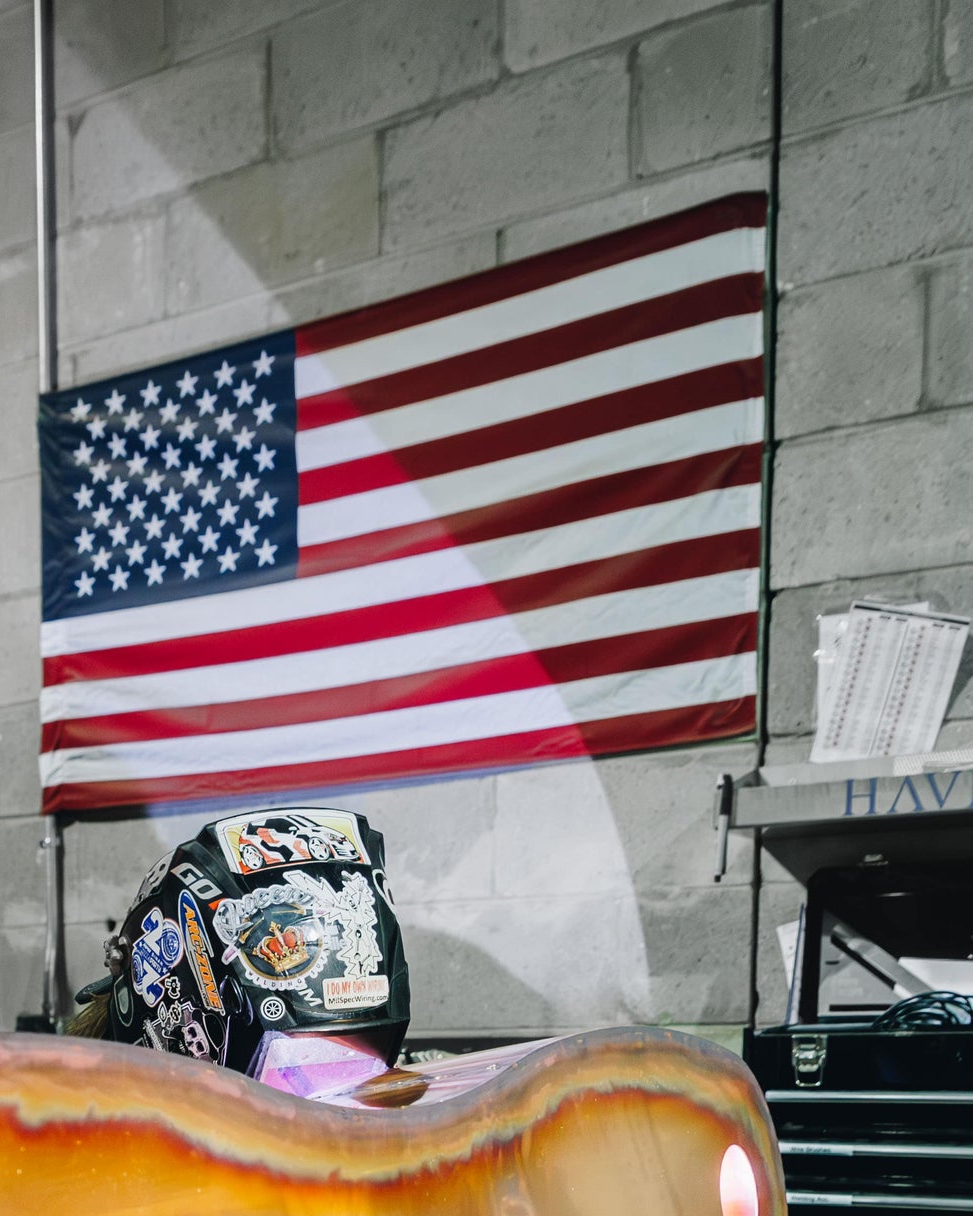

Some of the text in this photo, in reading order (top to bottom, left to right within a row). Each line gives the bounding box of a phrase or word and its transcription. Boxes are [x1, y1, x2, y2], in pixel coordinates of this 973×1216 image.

[843, 770, 973, 816] HAV
[170, 862, 223, 900] GO
[182, 902, 222, 1008] ARC-ZONE
[247, 971, 303, 988] WELDING
[331, 982, 340, 996] DO
[341, 981, 351, 994] MY
[328, 995, 388, 1005] MilSpecWiring.com
